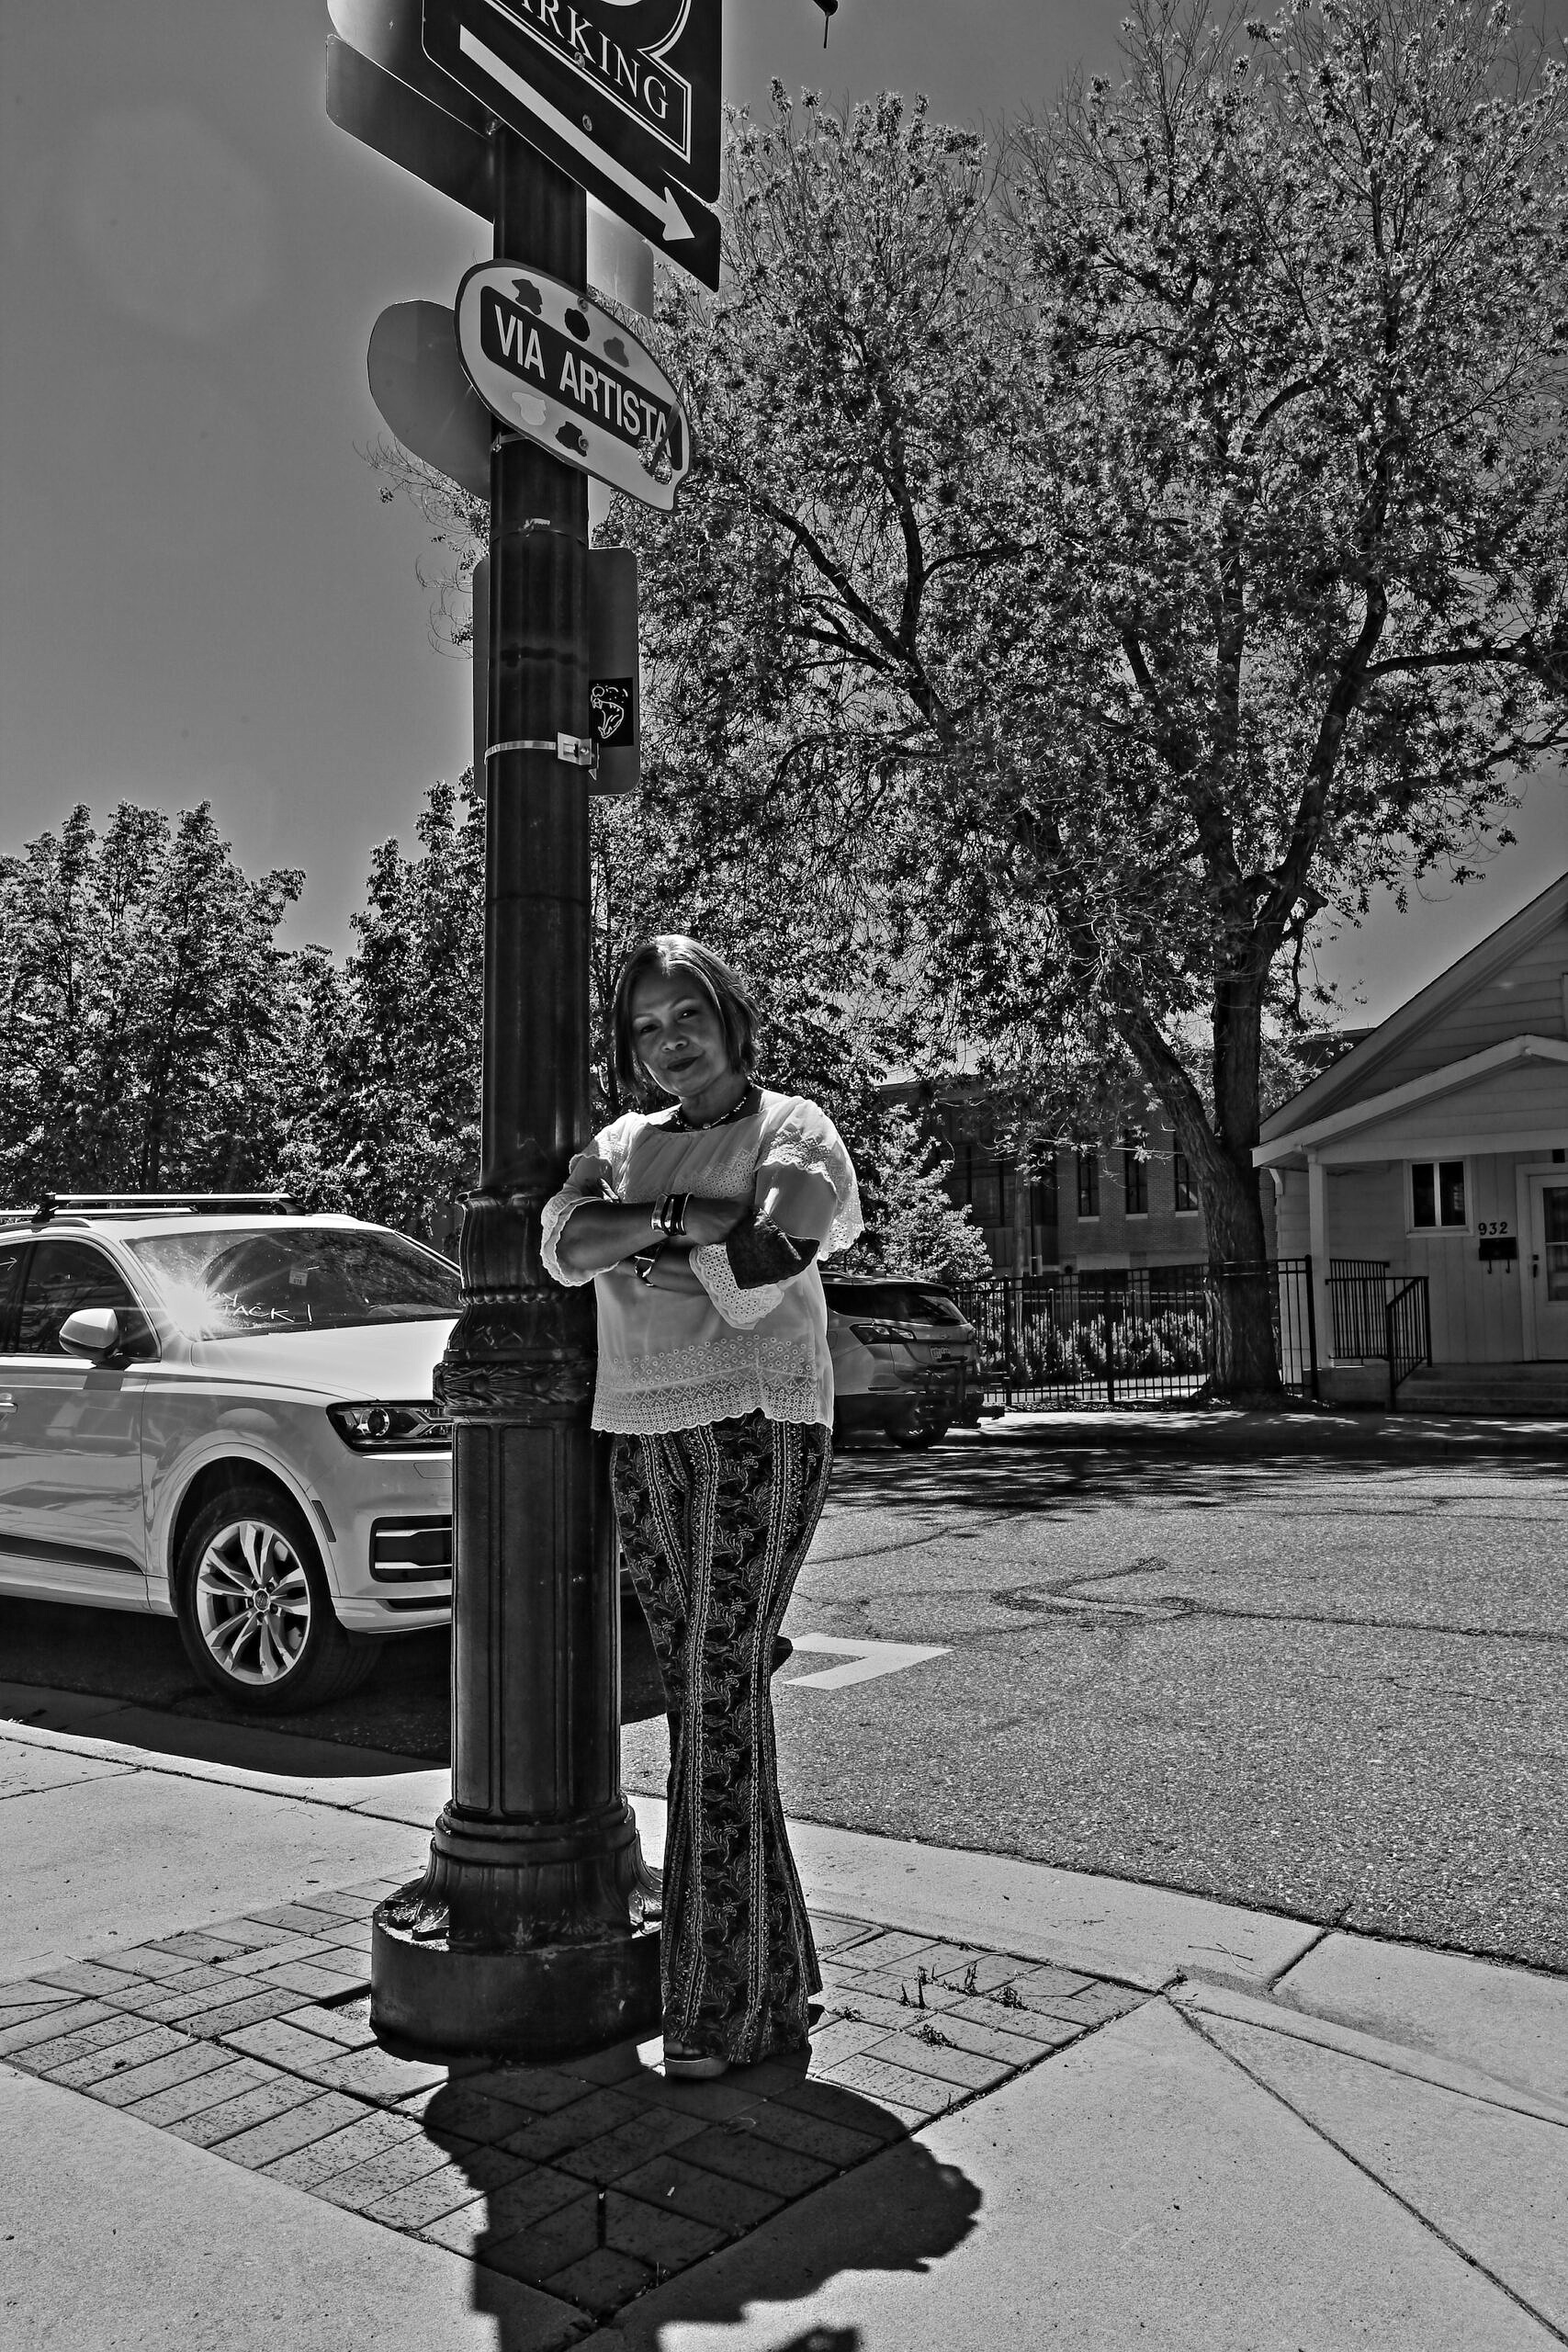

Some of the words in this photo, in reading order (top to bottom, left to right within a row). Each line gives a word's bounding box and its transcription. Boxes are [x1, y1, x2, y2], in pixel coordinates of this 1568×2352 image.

[522, 0, 669, 119] RKING
[494, 304, 546, 380] VIA
[559, 351, 671, 458] ARTISTA
[1478, 1221, 1508, 1236] 932
